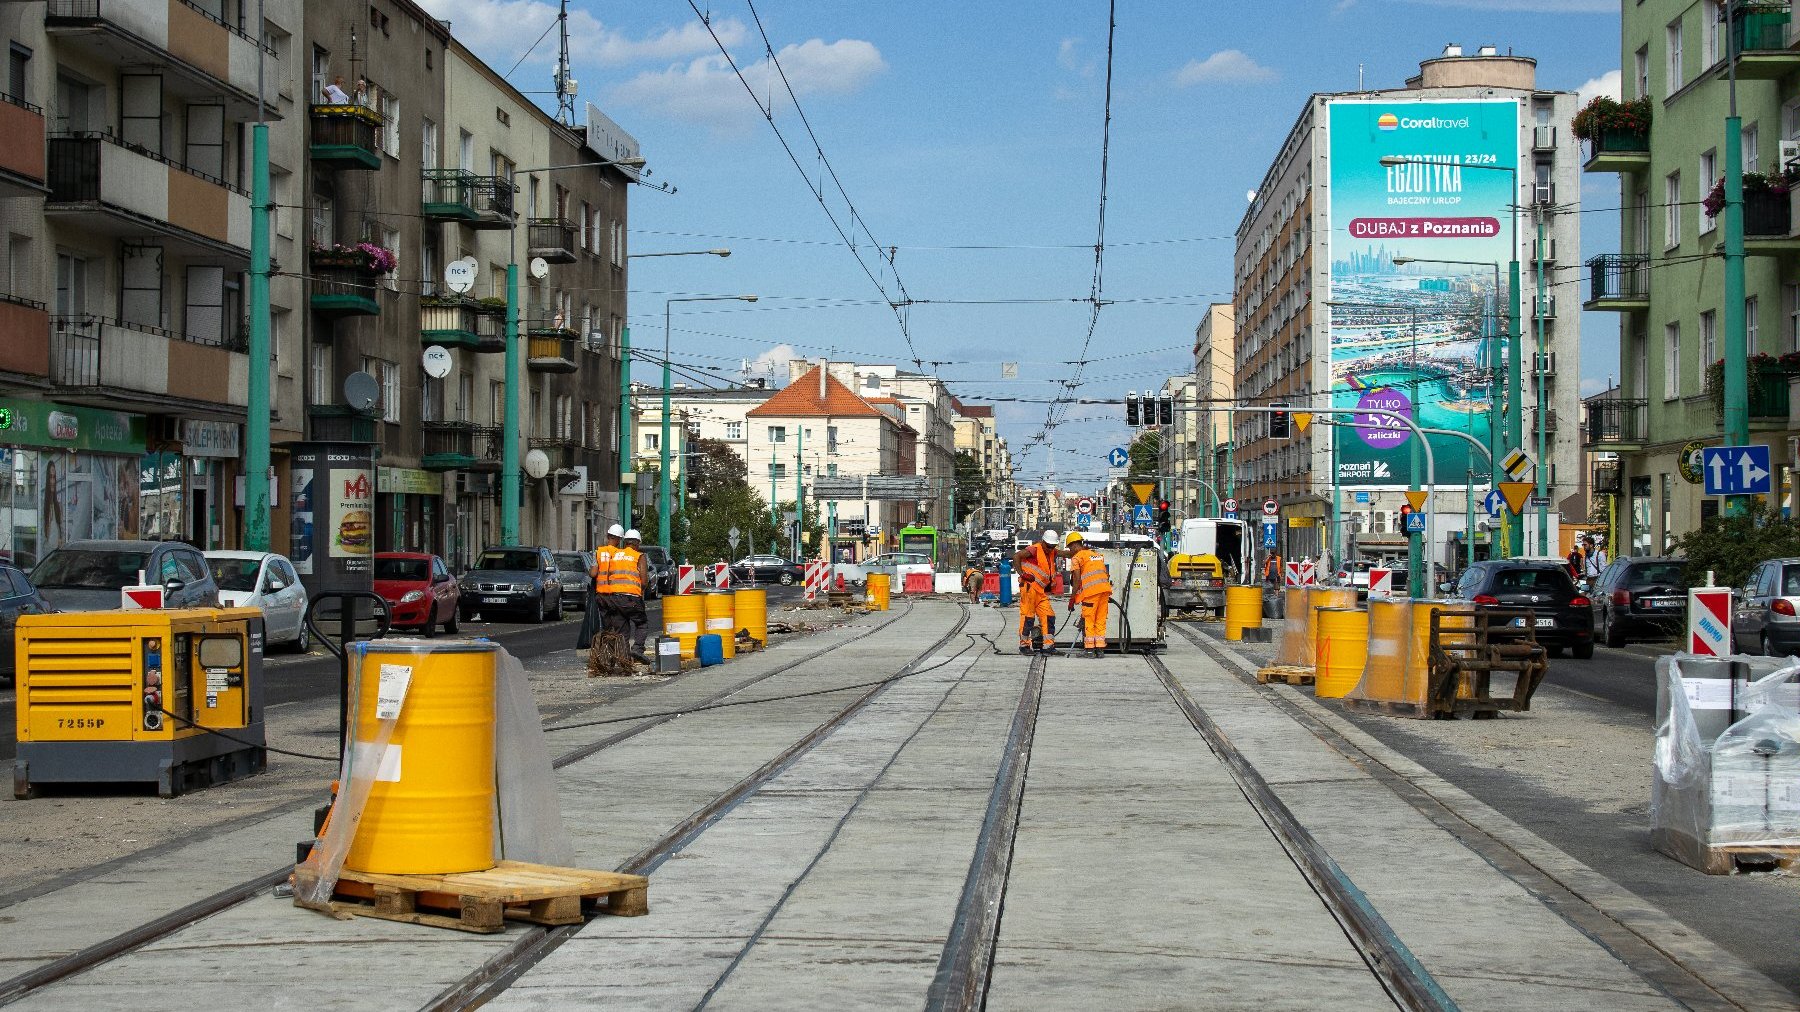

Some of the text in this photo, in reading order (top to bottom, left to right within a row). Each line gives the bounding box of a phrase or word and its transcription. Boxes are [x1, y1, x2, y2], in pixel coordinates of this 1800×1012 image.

[1387, 154, 1497, 193] EGZOTYKA 23/24
[1387, 196, 1462, 205] BAJECZNY URLOP
[1356, 221, 1494, 235] DUBAJ z Poznania
[1367, 399, 1401, 409] TYLKO
[186, 428, 237, 450] SKLEP RYBNY
[1367, 431, 1401, 440] zaliczki
[1226, 501, 1236, 509] 40
[57, 719, 105, 729] 7255P
